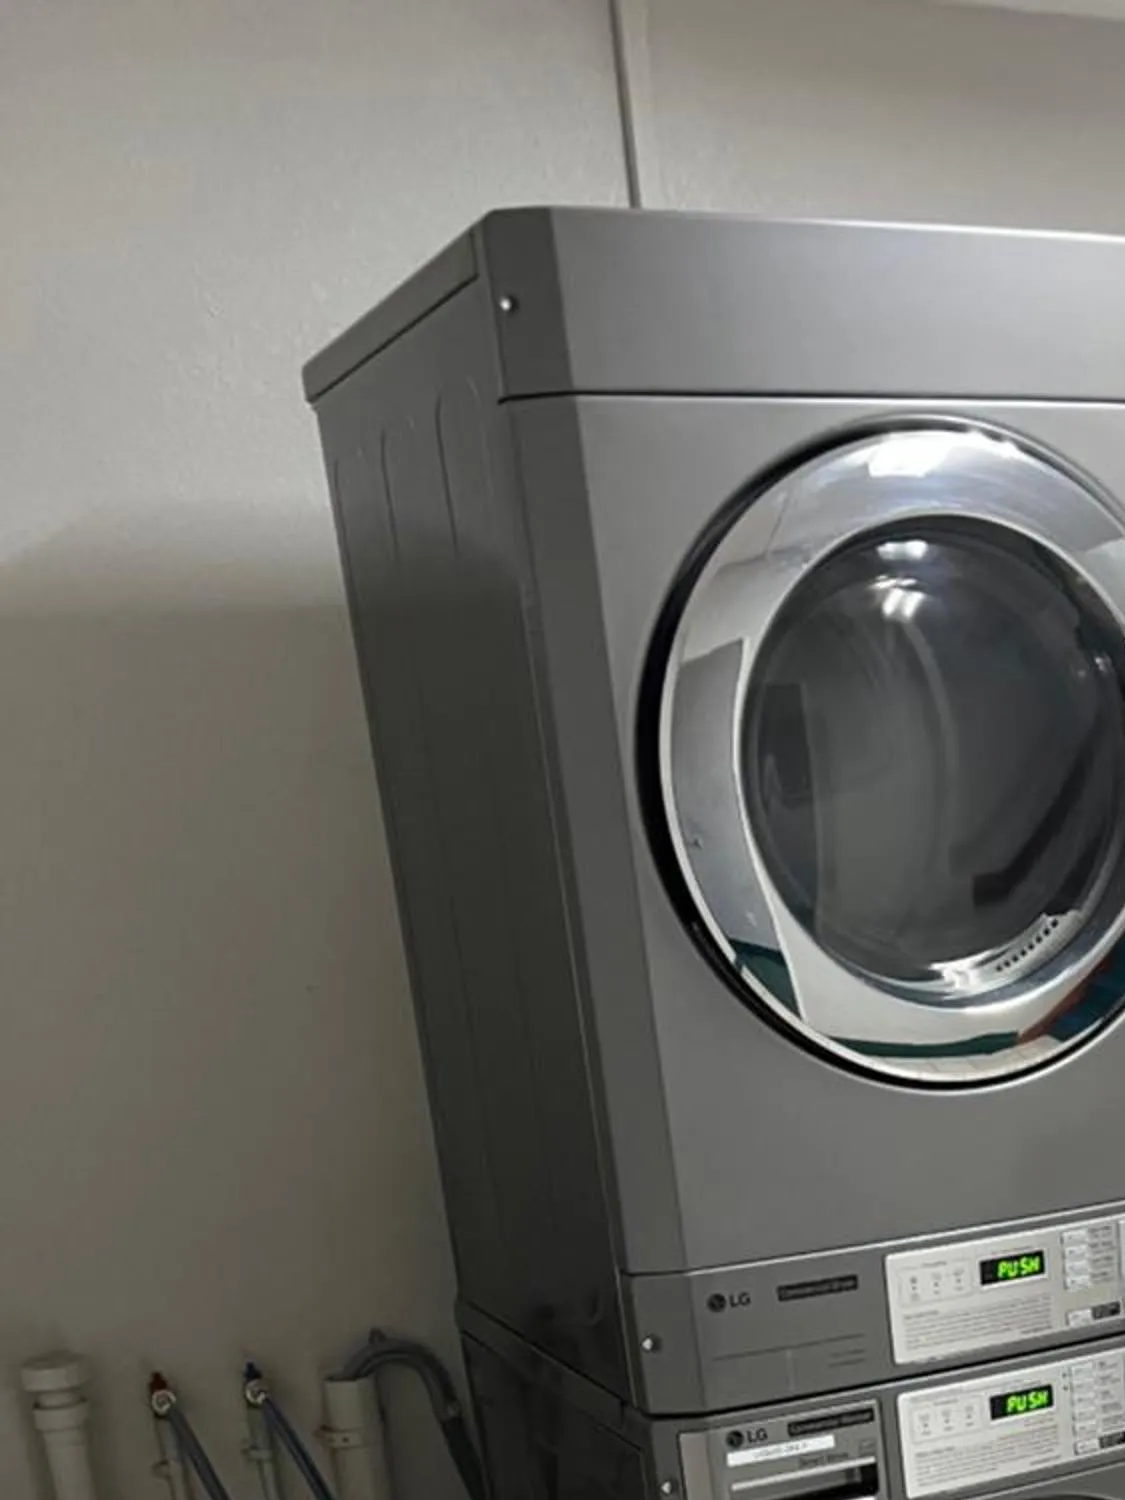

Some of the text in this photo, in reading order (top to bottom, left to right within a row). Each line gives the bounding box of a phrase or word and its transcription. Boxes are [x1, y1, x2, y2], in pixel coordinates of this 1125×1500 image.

[997, 1256, 1041, 1279] PUSH
[729, 1292, 751, 1308] LG
[1006, 1390, 1049, 1413] PUSH
[746, 1428, 768, 1443] LG
